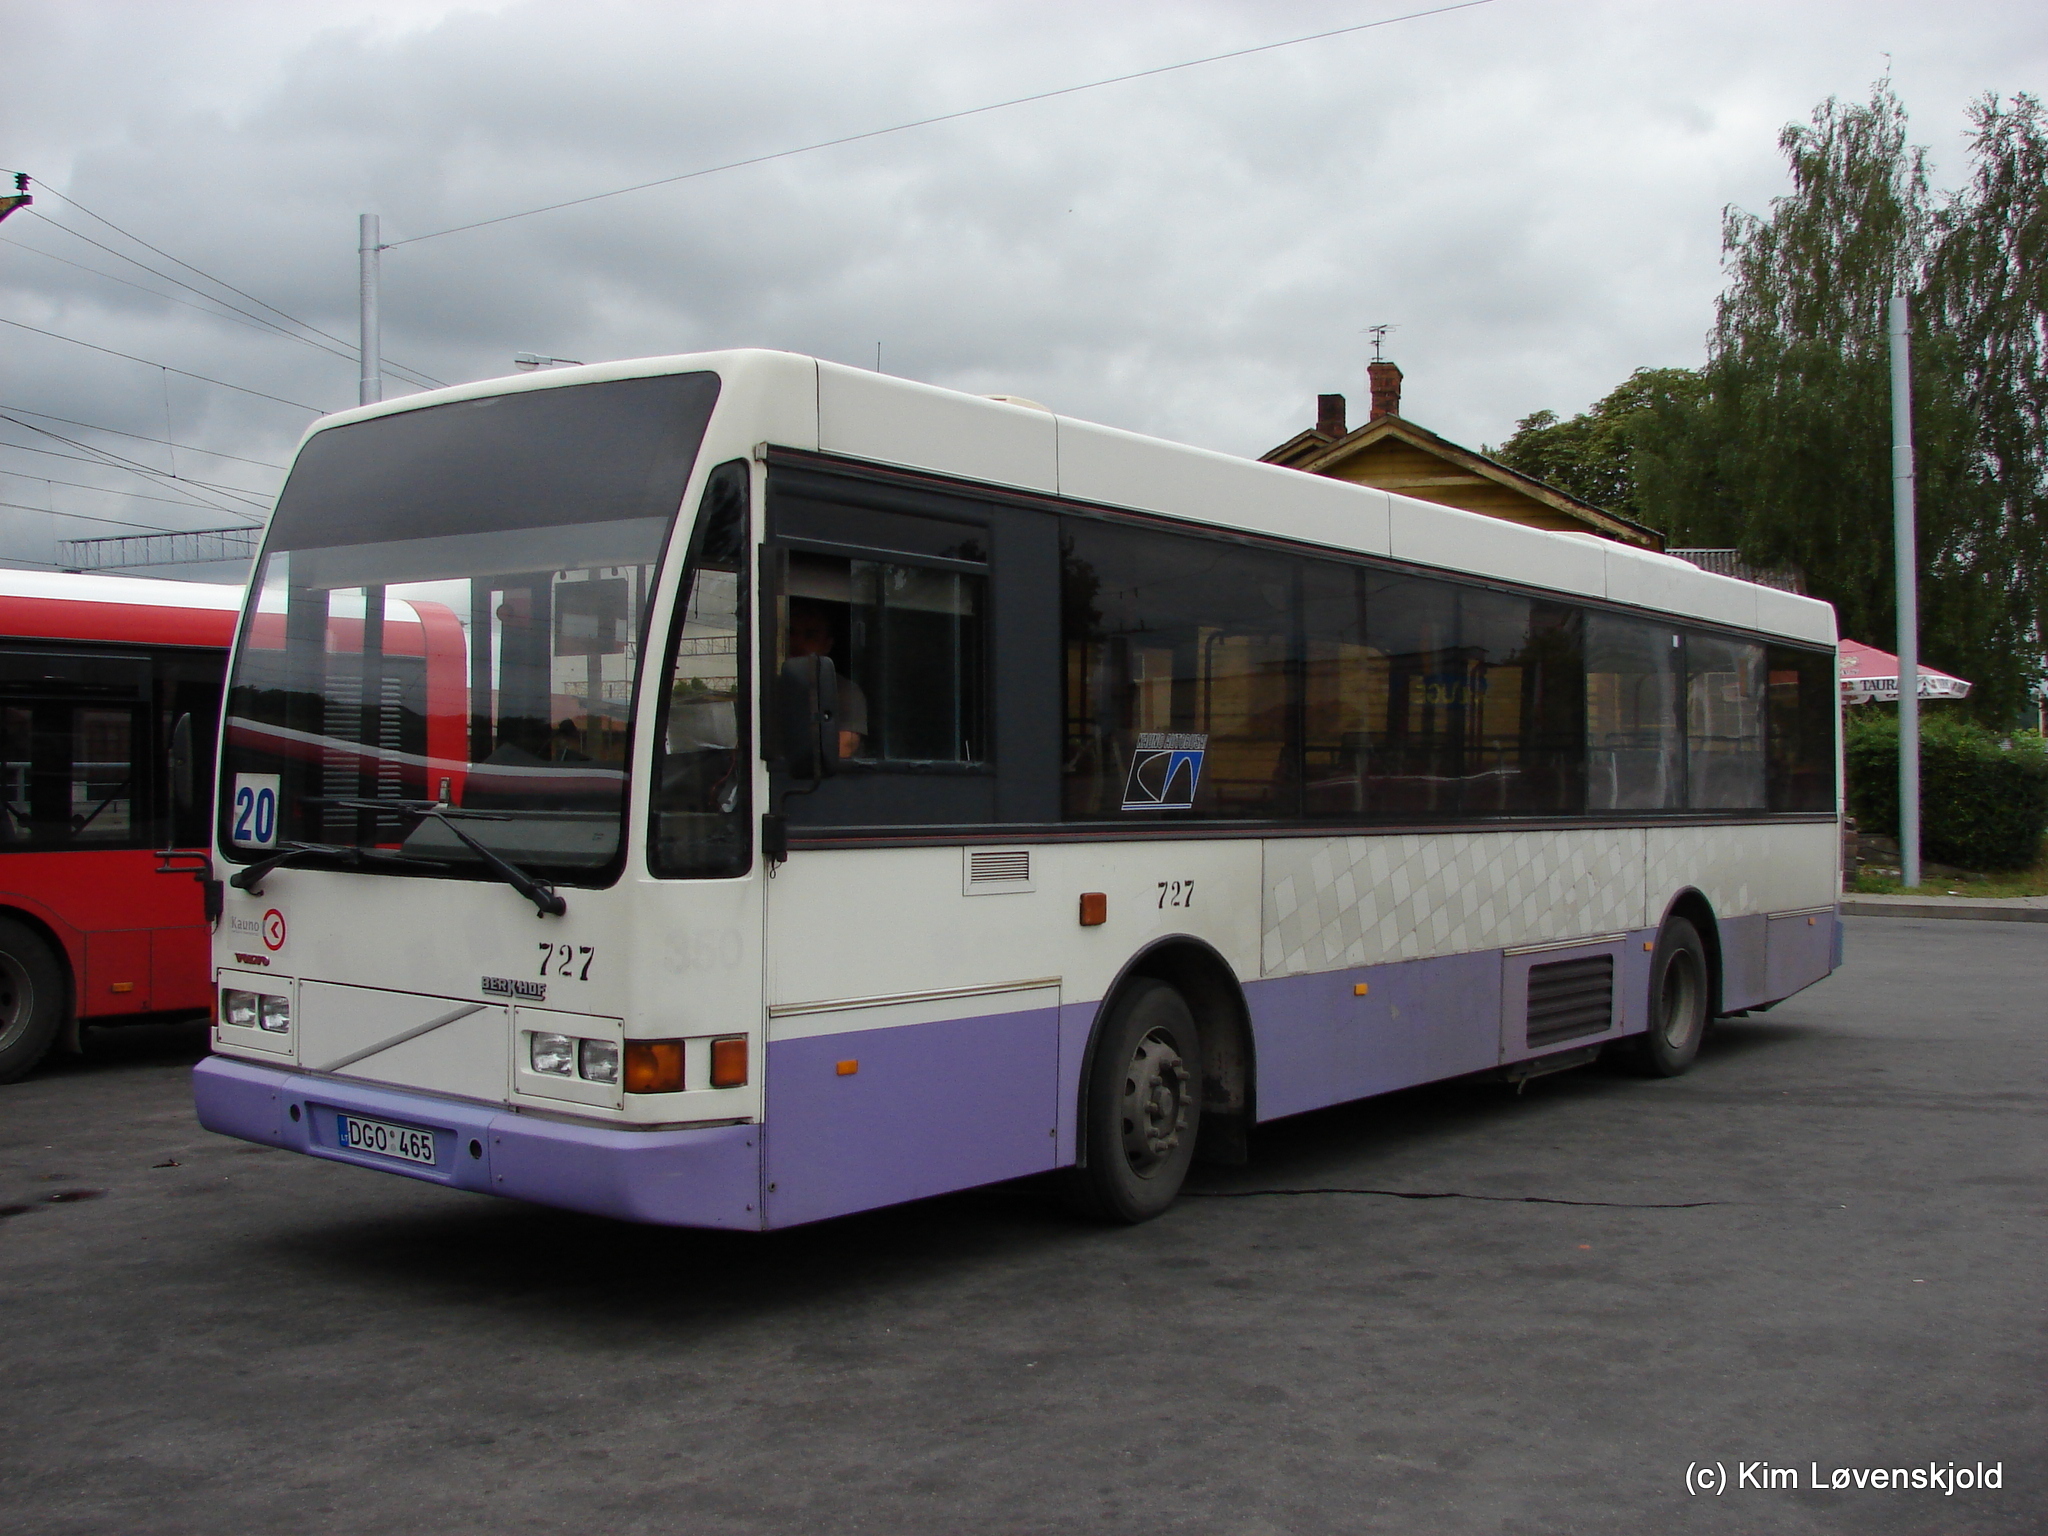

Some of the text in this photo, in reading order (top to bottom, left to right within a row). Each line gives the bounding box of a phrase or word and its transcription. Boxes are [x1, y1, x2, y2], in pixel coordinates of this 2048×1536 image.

[1860, 678, 1899, 691] TAUR
[234, 786, 275, 843] 20
[1158, 879, 1195, 909] 727
[231, 915, 260, 932] Kauno
[539, 942, 595, 981] 727
[481, 976, 547, 998] BERKHOF
[349, 1120, 432, 1160] DGO 465
